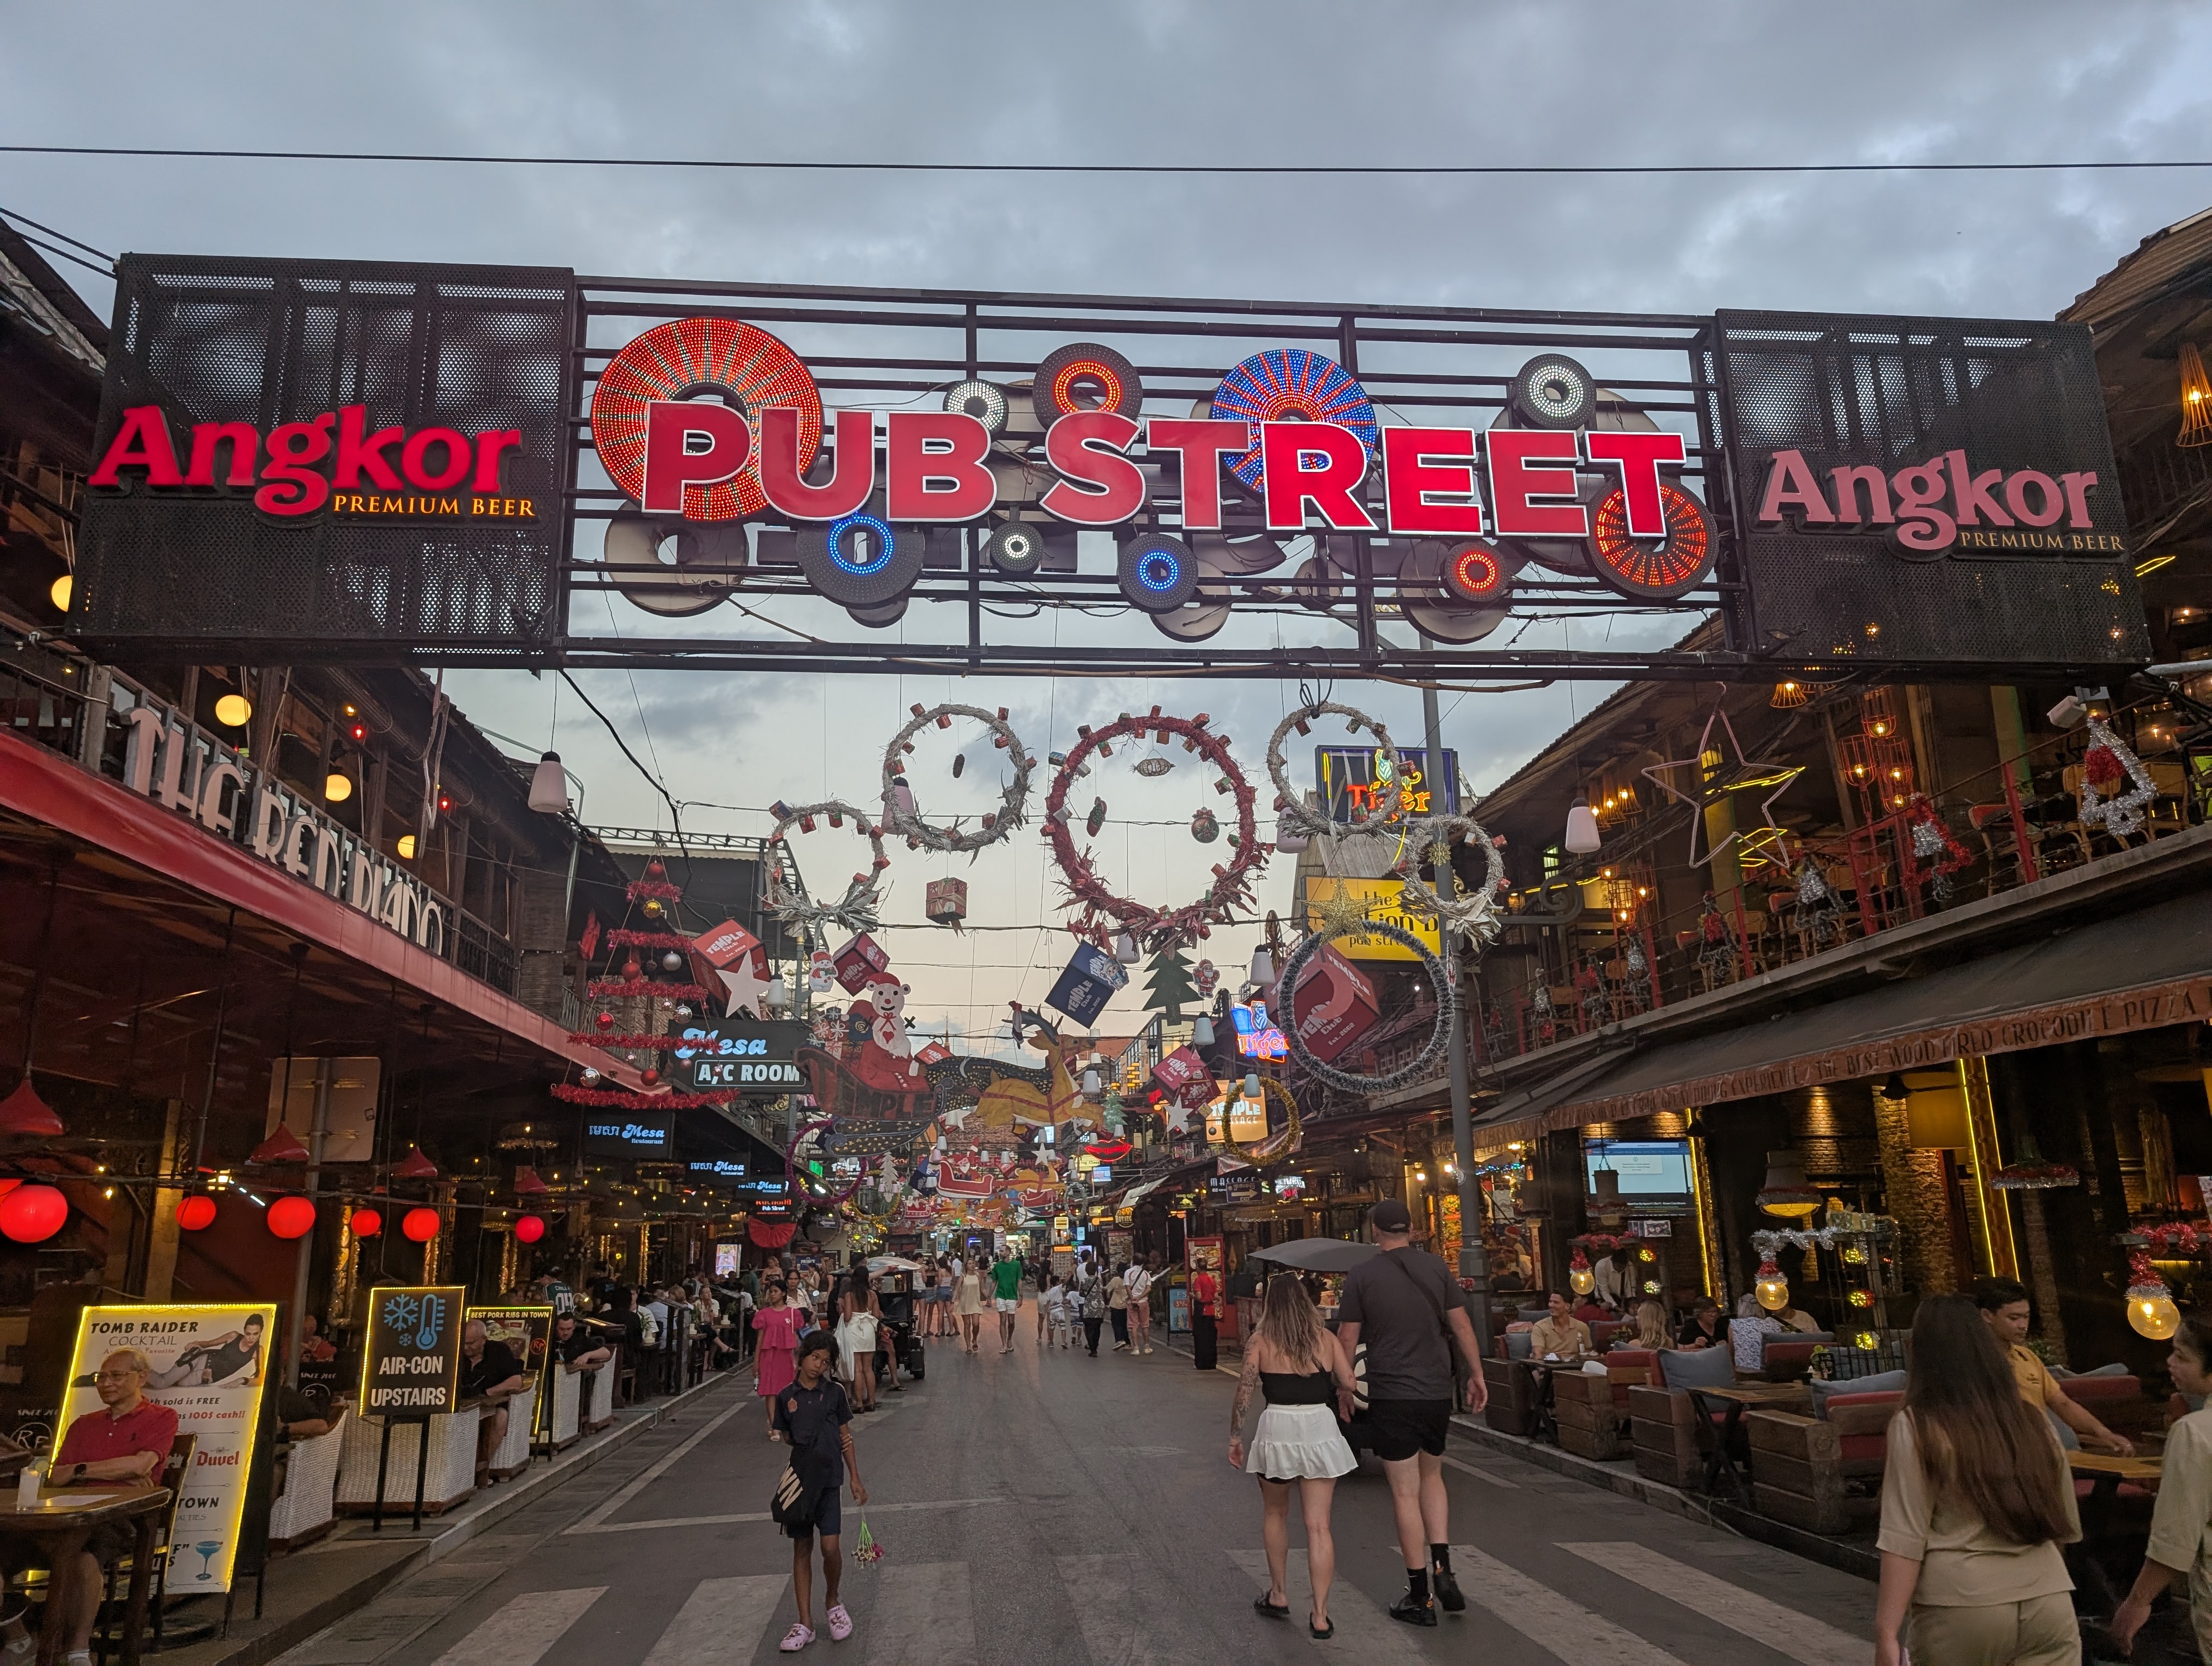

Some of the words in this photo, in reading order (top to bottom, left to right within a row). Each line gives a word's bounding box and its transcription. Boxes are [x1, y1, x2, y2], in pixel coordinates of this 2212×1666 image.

[88, 404, 520, 516] Angkor
[642, 399, 998, 522] PUB
[1039, 409, 1687, 537] STREET
[333, 495, 460, 515] PREMIUM
[471, 497, 536, 516] BEER
[1760, 449, 2098, 550] Angkor
[1961, 531, 2064, 549] PREMIUM
[2073, 535, 2125, 550] BEER
[111, 708, 245, 840] THE
[1346, 781, 1431, 821] Tier
[706, 930, 745, 954] TEMPLE
[722, 940, 738, 952] Club
[866, 944, 879, 962] TEMPLE
[840, 960, 867, 983] TEMPLE
[1089, 954, 1107, 977] TEMPLE
[1068, 980, 1093, 1012] TEMPLE
[1081, 994, 1092, 1008] Club
[1320, 1016, 1343, 1035] Club
[1328, 1035, 1341, 1046] Est.
[1339, 1022, 1356, 1036] 2002
[675, 1028, 768, 1059] Mesa
[1237, 1030, 1290, 1059] Tiger
[1732, 1066, 1800, 1097] EXPERIENCE
[1815, 1058, 1840, 1080] THE
[1847, 1050, 1880, 1075] BEST
[1888, 1040, 1935, 1068] WOOD
[1942, 1028, 1994, 1058] FIRED
[2002, 1005, 2113, 1046] CROCODILE
[2124, 990, 2197, 1027] PIZZA
[741, 1065, 800, 1081] ROOM
[1167, 1058, 1190, 1078] TEMPLE
[622, 1124, 665, 1138] Mesa
[1215, 1117, 1258, 1125] MSSAGE
[714, 1161, 744, 1172] Mesa
[757, 1181, 782, 1190] Mesa
[91, 1322, 134, 1334] TOMB
[140, 1322, 198, 1333] RAIDER
[108, 1336, 177, 1346] COCKTAIL
[380, 1356, 443, 1375] AIR-CON
[370, 1387, 446, 1407] UPSTAIRS
[189, 1412, 213, 1420] 100$
[216, 1410, 246, 1419] cash!!
[197, 1450, 240, 1466] Duvel
